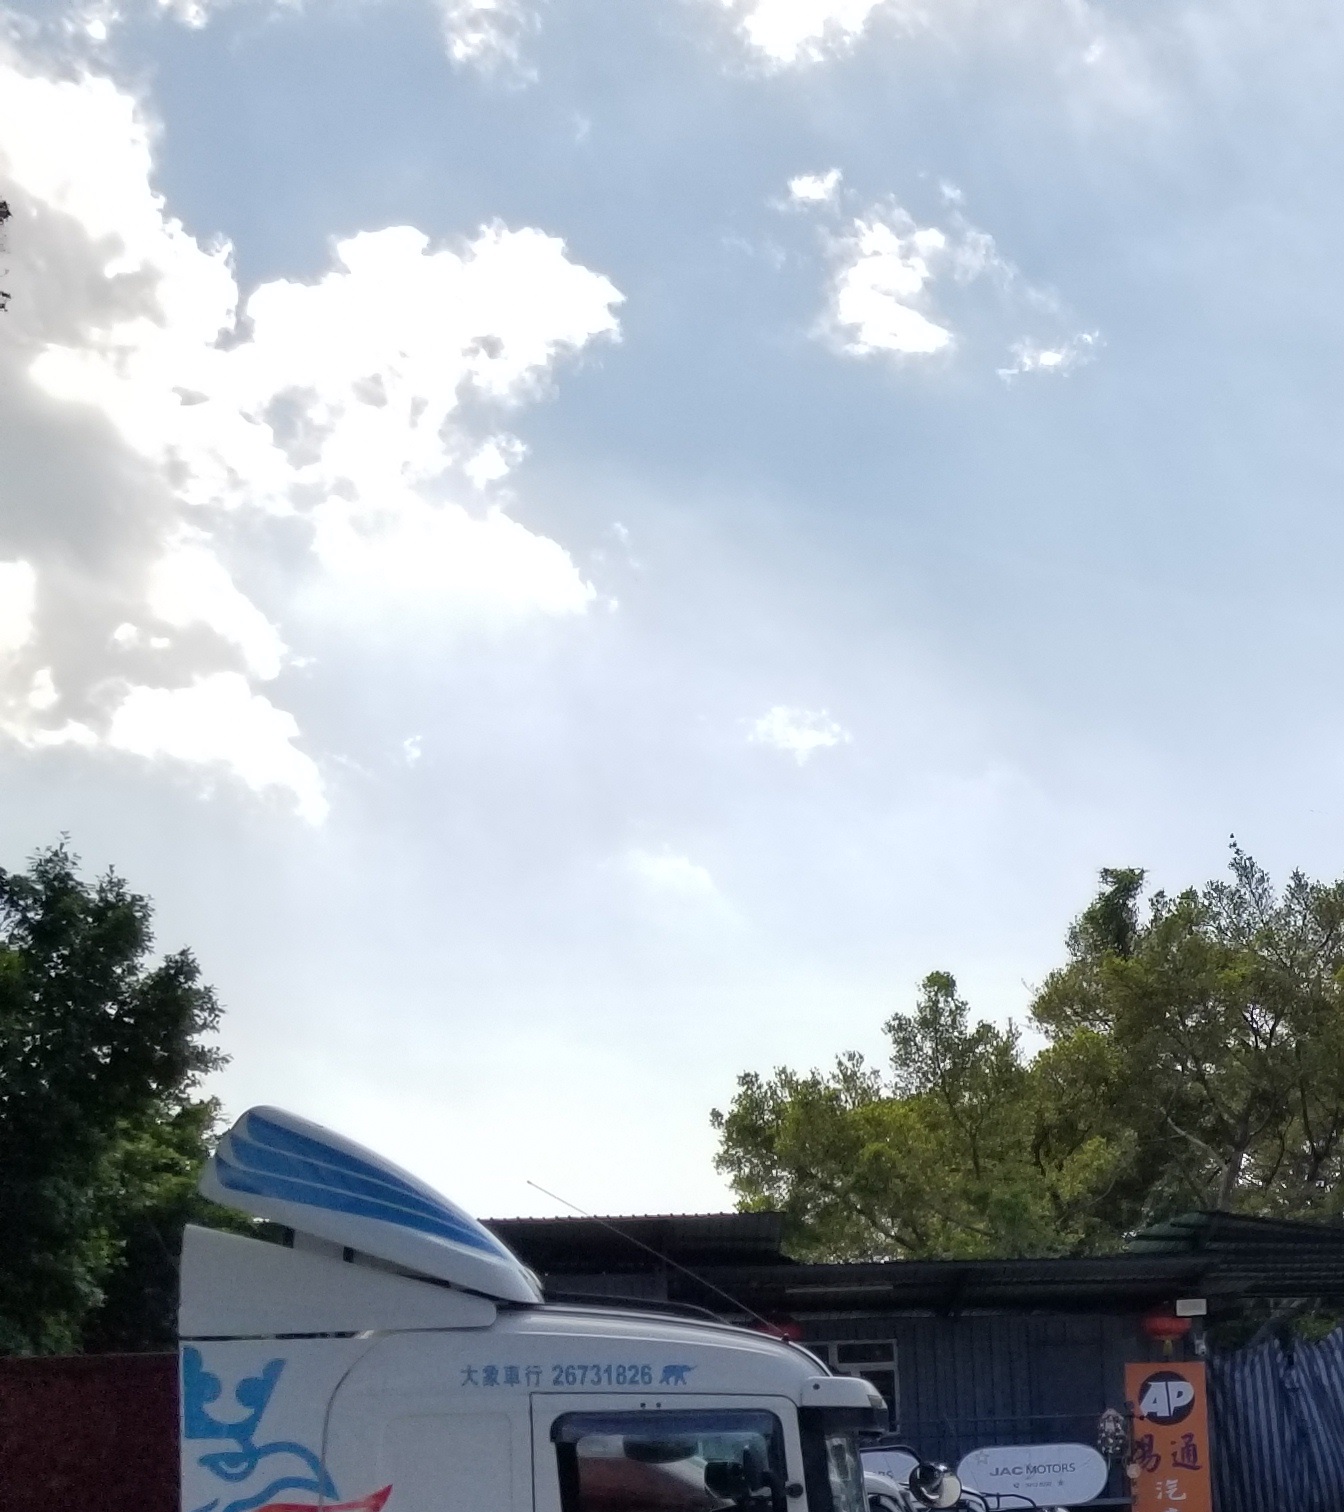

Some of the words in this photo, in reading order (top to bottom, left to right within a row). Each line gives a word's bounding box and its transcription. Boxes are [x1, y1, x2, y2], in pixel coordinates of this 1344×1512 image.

[552, 1364, 653, 1386] 26731826
[1140, 1381, 1195, 1418] AP
[989, 1466, 1023, 1477] JAC
[1025, 1462, 1076, 1476] MOTORS
